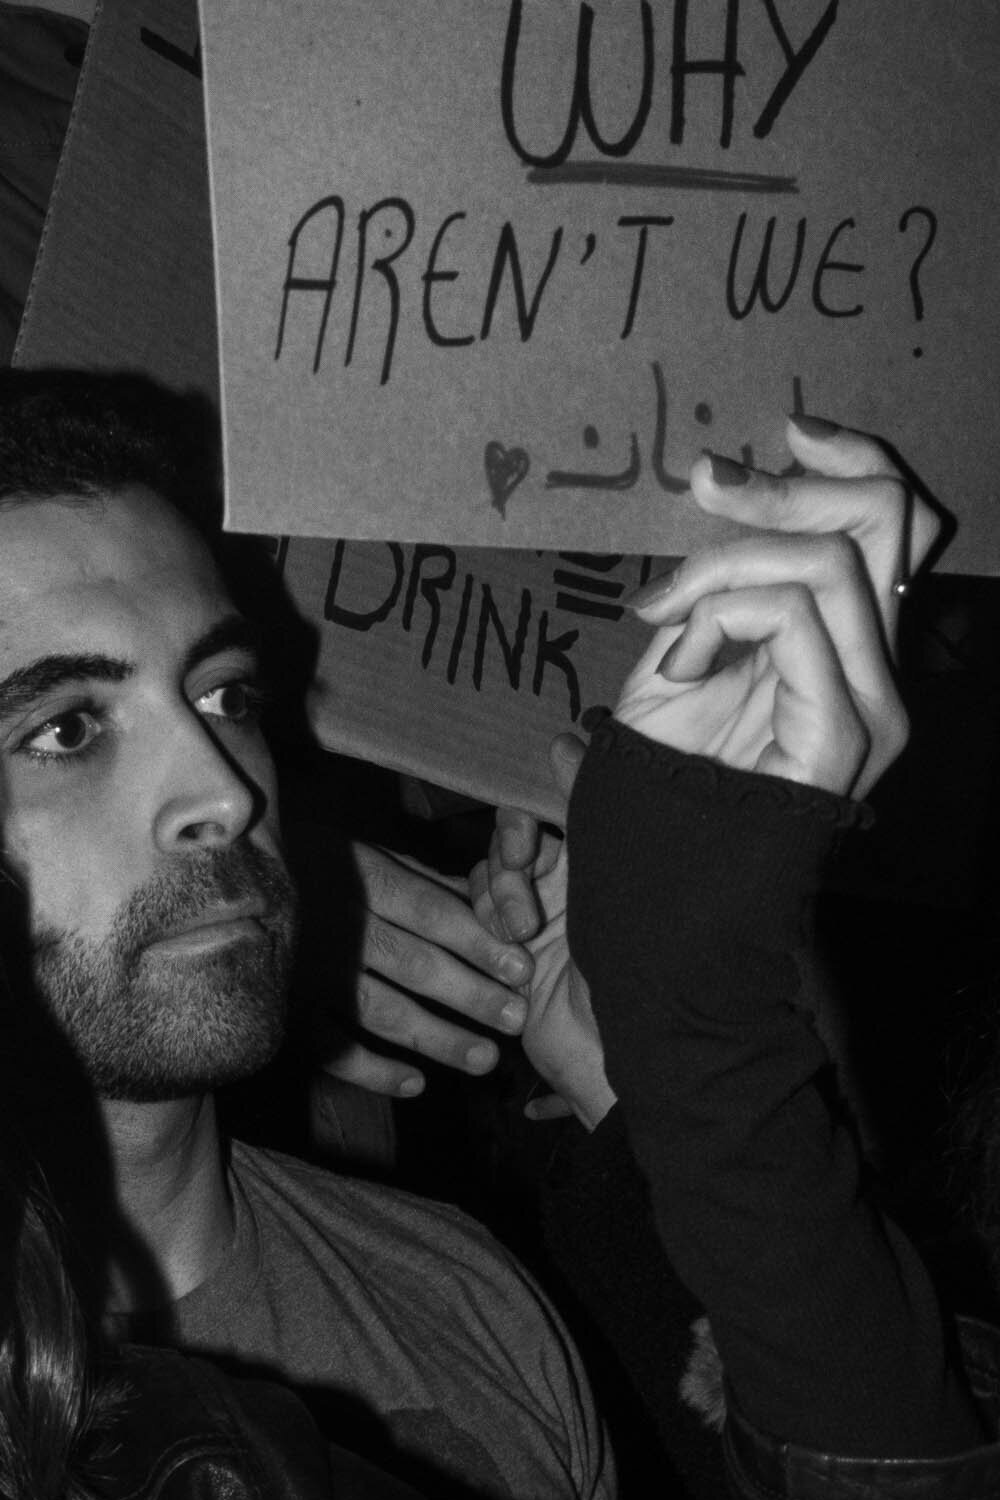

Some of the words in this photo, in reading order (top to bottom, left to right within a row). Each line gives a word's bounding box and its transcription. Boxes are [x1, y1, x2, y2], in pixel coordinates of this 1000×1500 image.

[501, 0, 838, 169] WHY
[275, 195, 675, 386] AREN'T
[324, 536, 581, 723] DRINK
